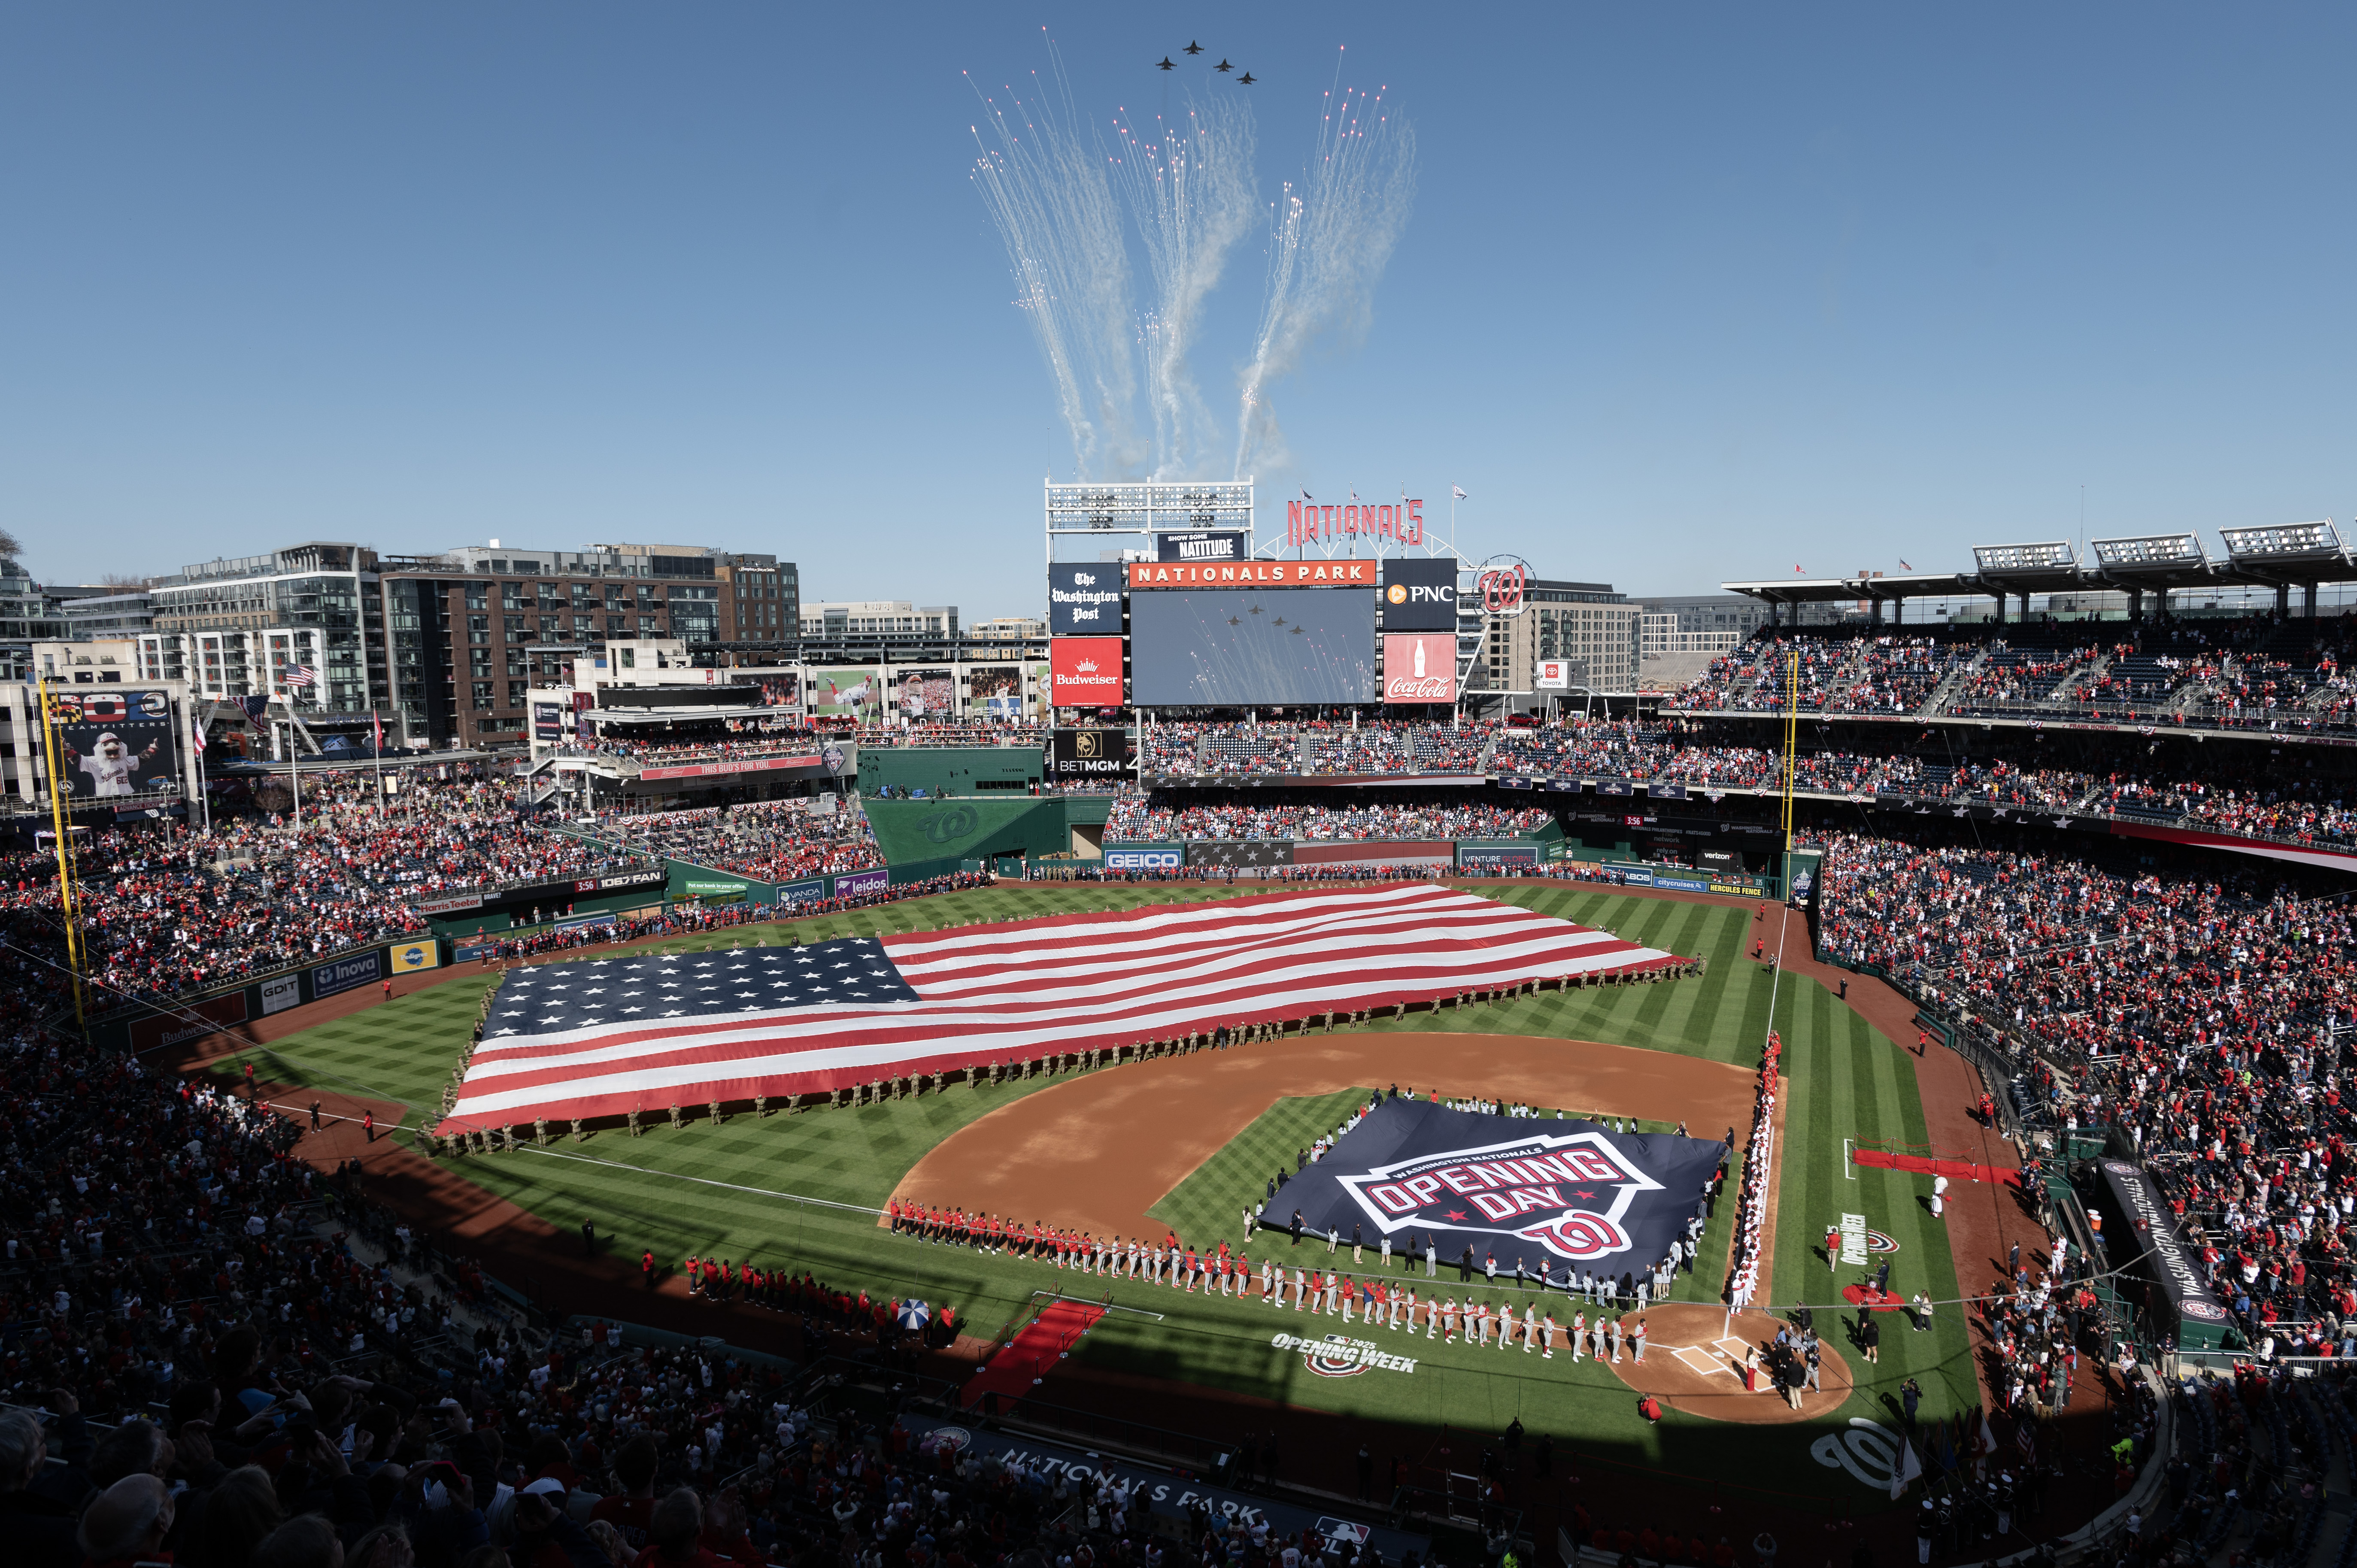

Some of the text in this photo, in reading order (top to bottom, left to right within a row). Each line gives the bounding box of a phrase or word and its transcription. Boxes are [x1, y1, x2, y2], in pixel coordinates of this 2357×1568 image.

[1288, 499, 1423, 546] NATIONALS
[1179, 539, 1233, 557] NATITUDE
[1074, 572, 1096, 586] The
[1138, 566, 1362, 582] NATIONALS PARK
[1052, 588, 1119, 605] Washington
[1409, 586, 1453, 602] PNC
[1073, 608, 1099, 624] Post
[1056, 674, 1118, 685] Budweiser
[1387, 676, 1453, 699] Coca-Cola
[48, 722, 166, 730] TEAMFITTERS
[701, 760, 771, 774] THIS BUD'S FOR YOU.
[1060, 760, 1120, 771] BETMGM
[143, 800, 159, 808] TICKET
[1627, 817, 1641, 825] 3:56
[1107, 854, 1178, 867] GEICO
[632, 872, 660, 883] FAN
[852, 878, 886, 893] leidos
[1658, 879, 1695, 888] citycruises
[578, 881, 594, 891] 3:56
[789, 888, 820, 899] VANDA
[1710, 884, 1762, 896] HERCULES FENCE
[483, 892, 501, 900] BRAVE?
[420, 897, 480, 913] Harris Teeter
[400, 951, 428, 961] Pedigree
[336, 957, 376, 979] Inova
[264, 981, 297, 998] GDIT
[160, 1018, 221, 1045] Budweiser
[1393, 1147, 1543, 1179] WASHINGTON NATIONALS
[1366, 1148, 1625, 1214] OPENING
[1465, 1186, 1573, 1223] DAY
[2120, 1177, 2163, 1228] NATIONALS
[1840, 1213, 1866, 1232] WEEK
[1840, 1232, 1868, 1265] OPENING
[2151, 1227, 2205, 1296] WASHINGTON
[1350, 1339, 1377, 1350] 2025
[1271, 1333, 1418, 1374] OPENING WEEK
[1176, 1491, 1262, 1524] PARK
